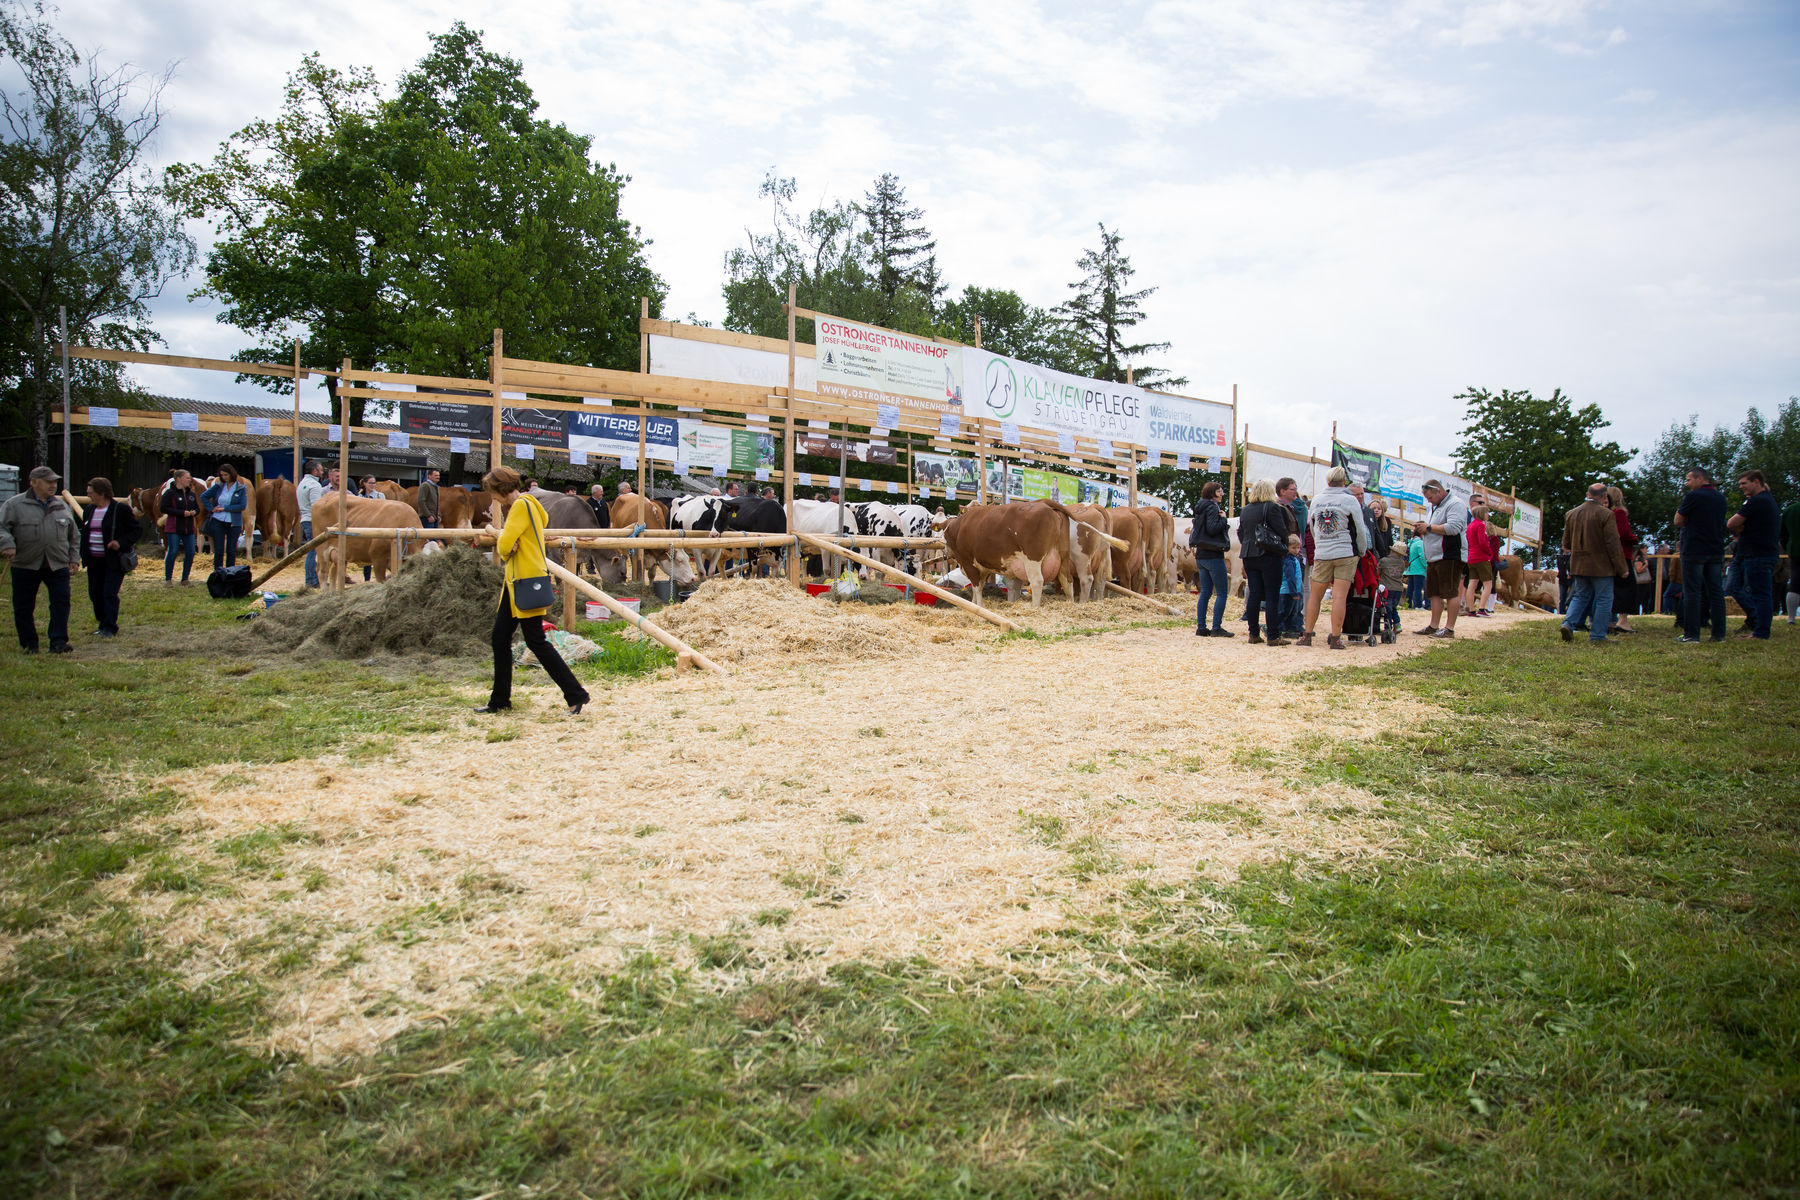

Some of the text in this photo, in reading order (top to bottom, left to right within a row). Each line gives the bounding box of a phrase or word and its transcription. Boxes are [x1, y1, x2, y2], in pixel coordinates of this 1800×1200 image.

[822, 336, 839, 345] JOSEF
[1023, 375, 1140, 419] KLAUENPFLEGE
[1150, 405, 1192, 422] Waldviertler
[1149, 420, 1216, 445] SPARKASSE
